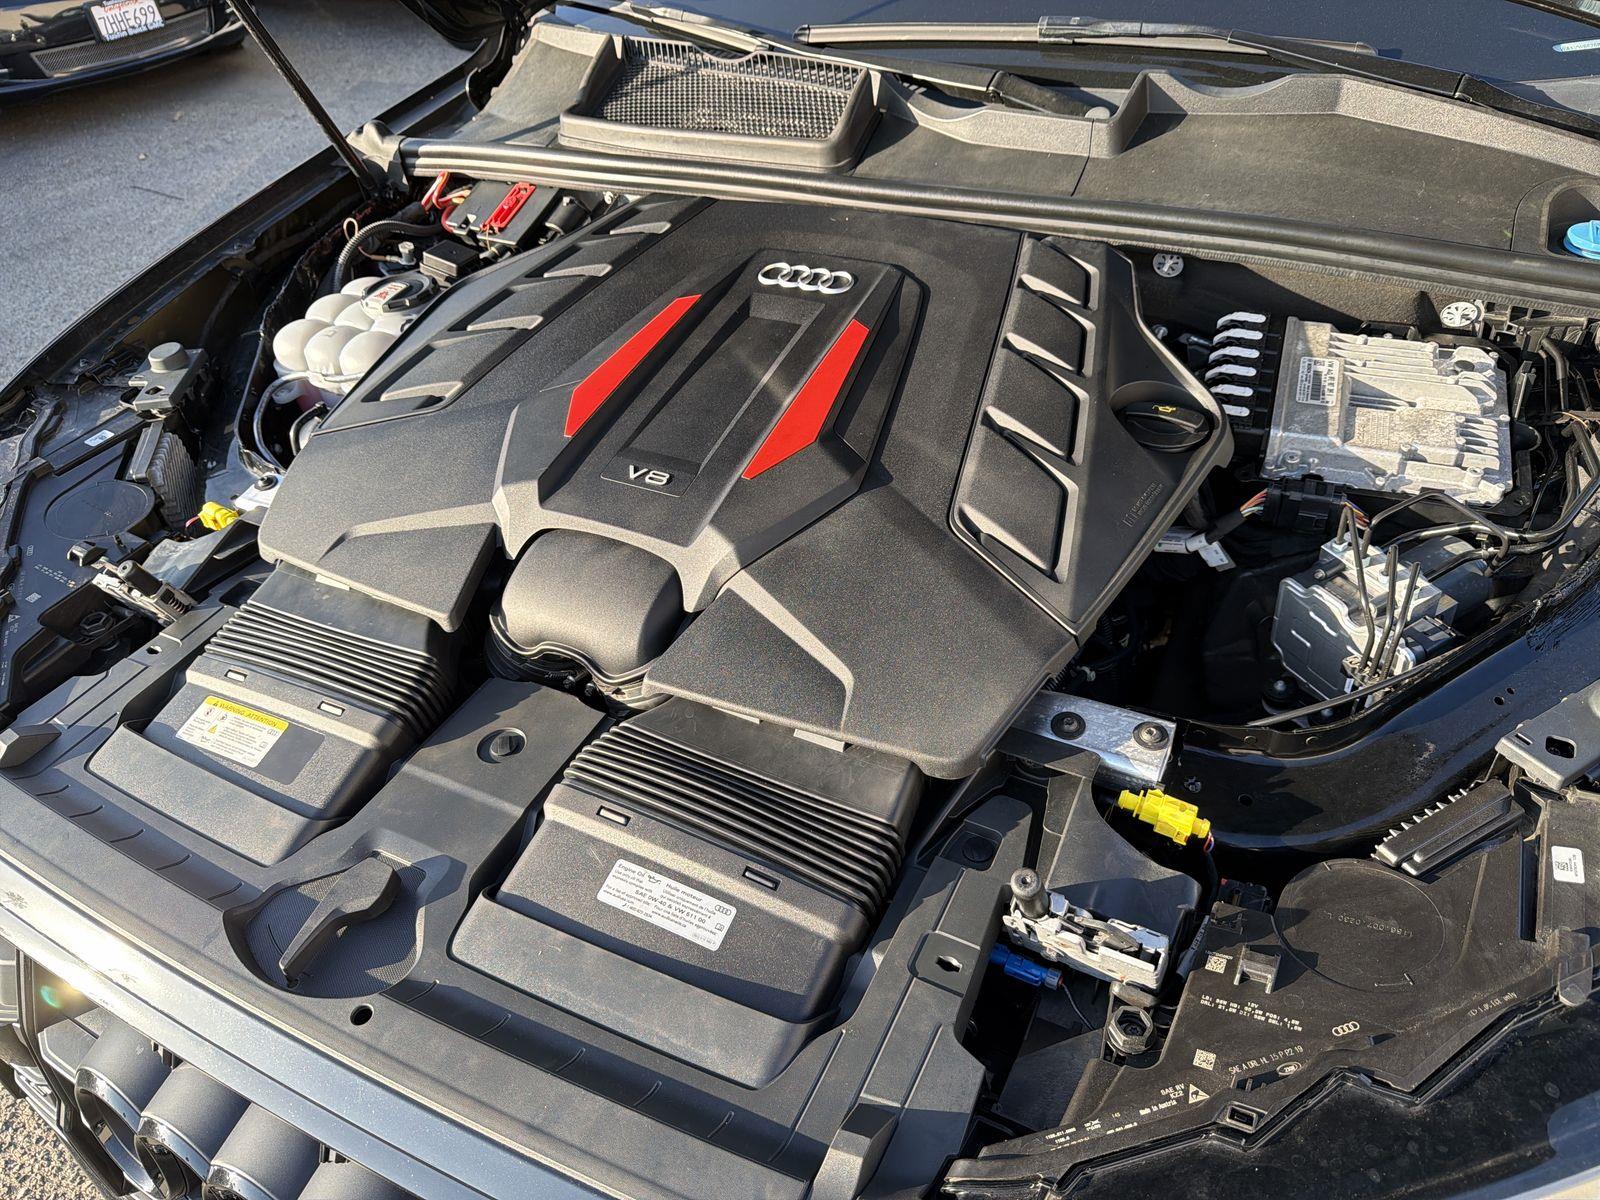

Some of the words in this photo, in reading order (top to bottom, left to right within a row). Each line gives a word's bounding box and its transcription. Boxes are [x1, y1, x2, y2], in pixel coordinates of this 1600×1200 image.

[98, 5, 155, 34] 7HHE699
[629, 464, 670, 486] V8
[219, 702, 245, 716] WARNING
[246, 710, 278, 728] ATTENTION
[618, 863, 637, 874] Engine
[635, 889, 647, 898] SAE
[648, 895, 667, 906] 0W-40
[674, 906, 685, 914] VW
[680, 890, 702, 902] moteur
